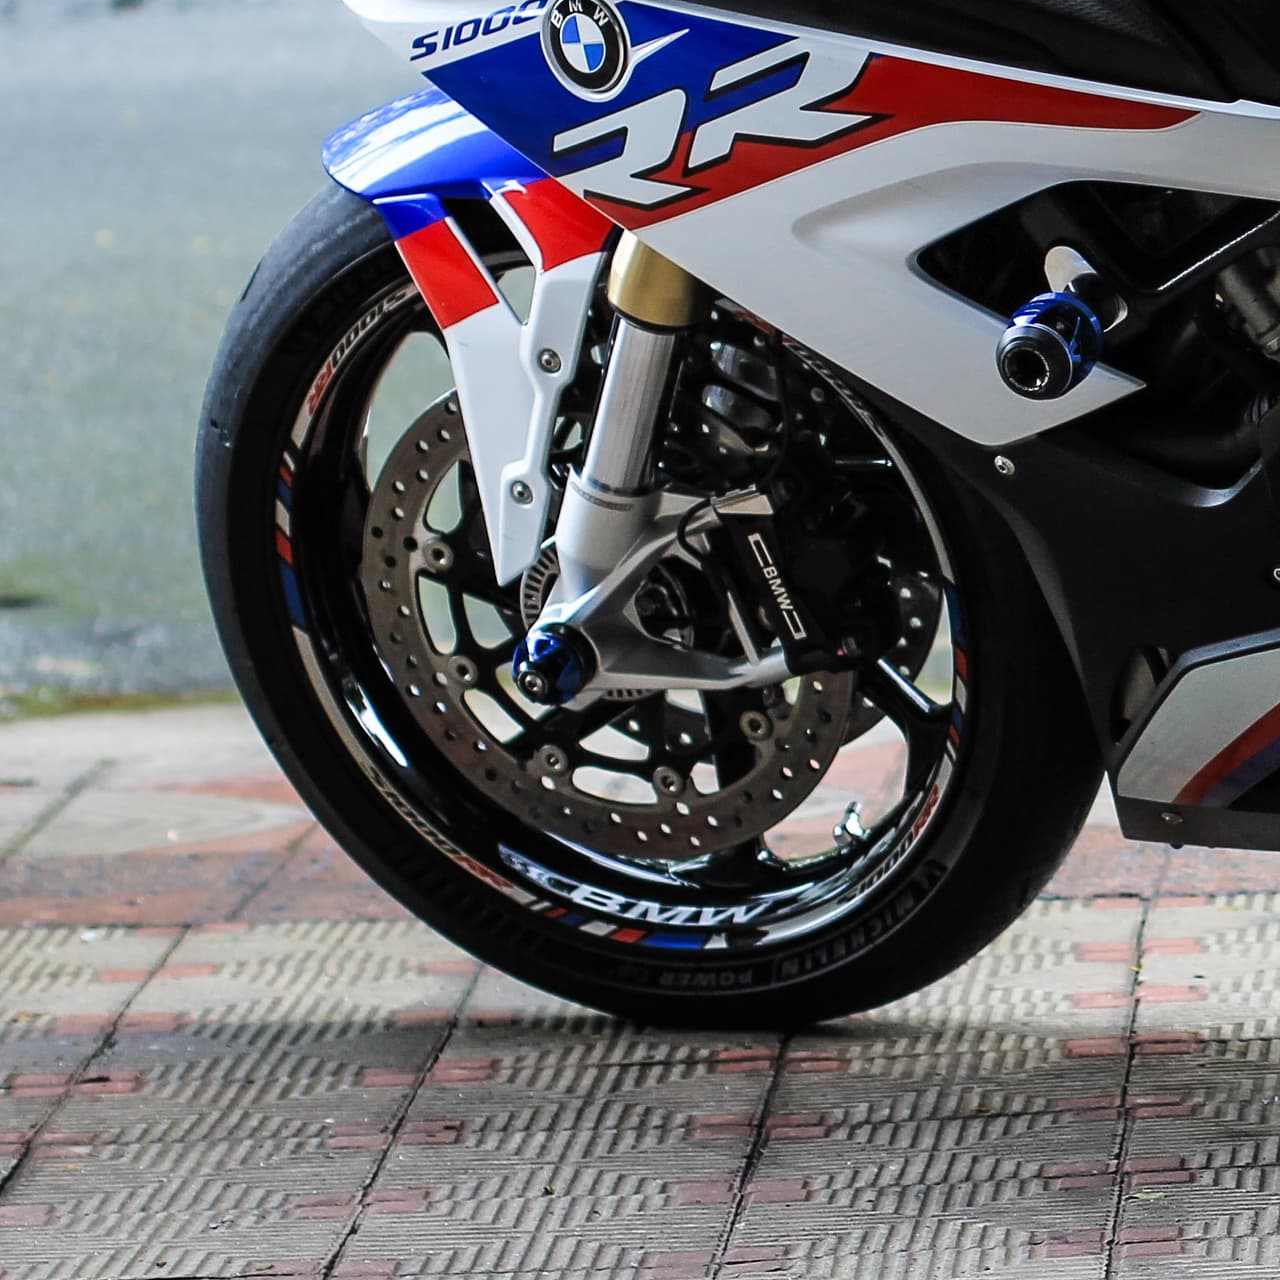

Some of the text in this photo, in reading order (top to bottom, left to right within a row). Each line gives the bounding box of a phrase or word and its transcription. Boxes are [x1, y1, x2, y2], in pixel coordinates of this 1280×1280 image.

[552, 50, 888, 209] RR
[762, 565, 794, 610] BMW
[570, 883, 775, 927] BMW
[657, 889, 915, 987] MICHELIN POWER
